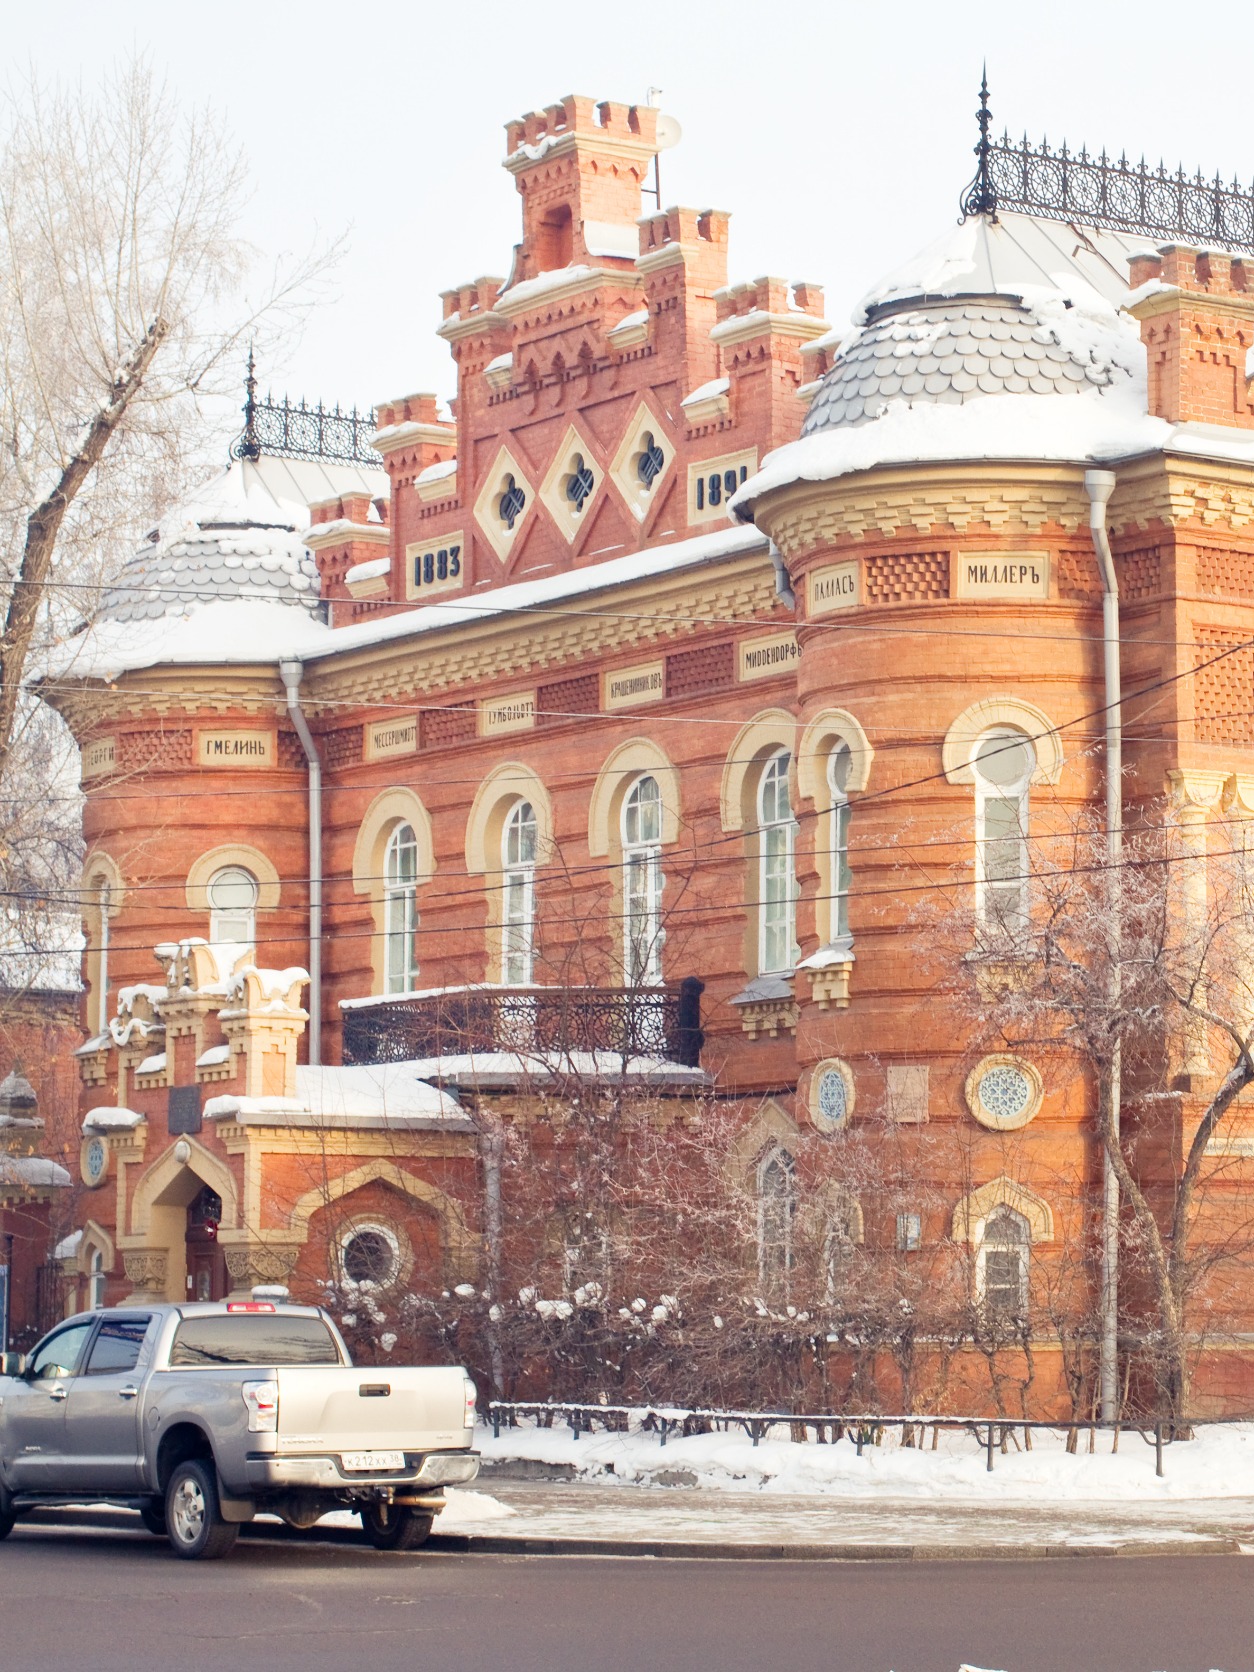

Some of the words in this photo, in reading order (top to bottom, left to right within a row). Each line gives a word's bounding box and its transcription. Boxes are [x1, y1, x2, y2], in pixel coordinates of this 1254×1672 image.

[414, 546, 461, 587] 1883
[967, 565, 1040, 584] МИЛЛЕРЪ
[814, 574, 855, 602] ПАЛЛАСЪ
